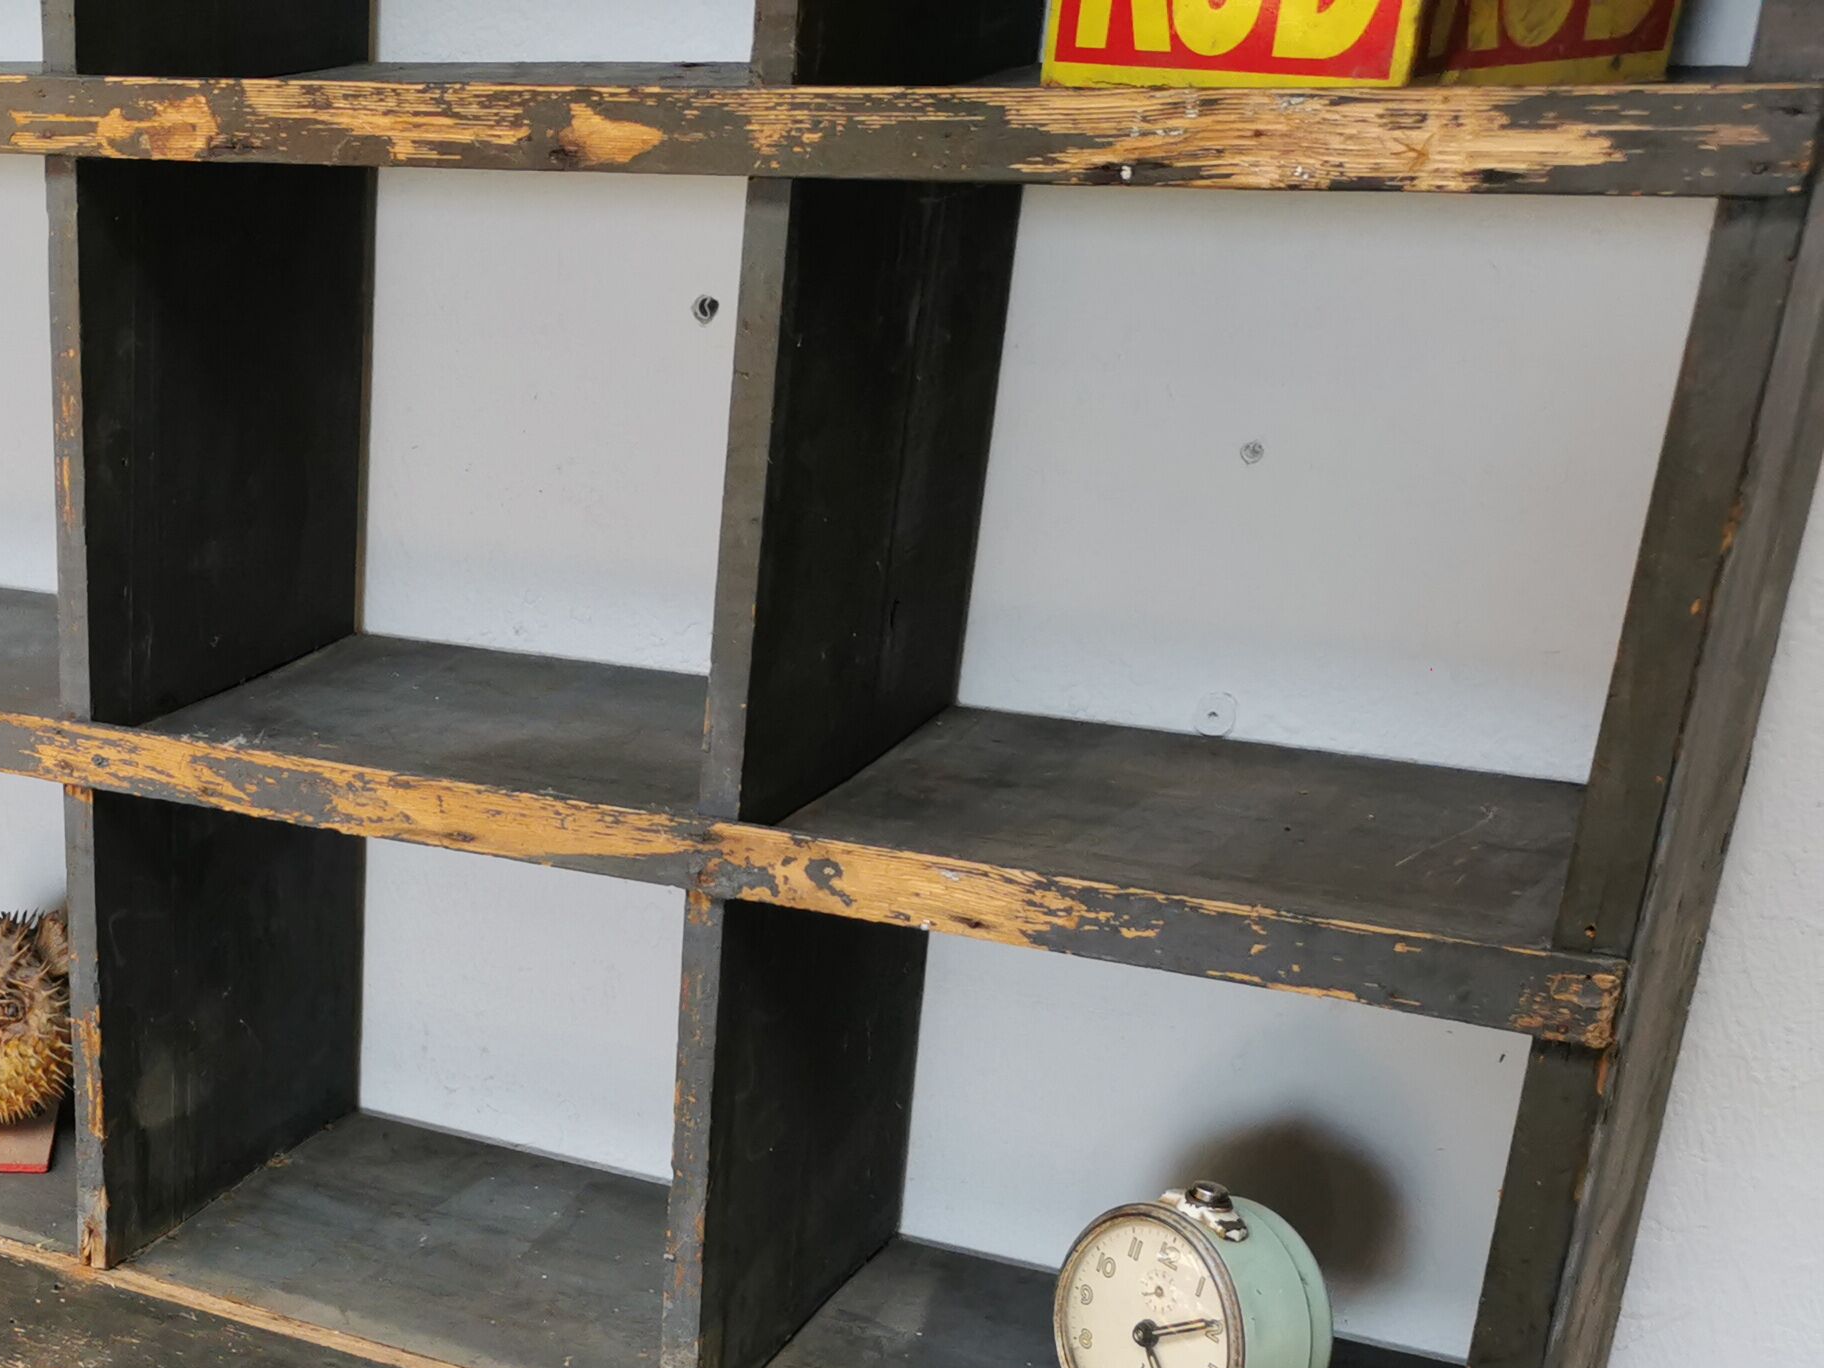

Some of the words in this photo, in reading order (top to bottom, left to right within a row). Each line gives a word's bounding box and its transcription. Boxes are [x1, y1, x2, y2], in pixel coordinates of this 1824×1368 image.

[1127, 1237, 1144, 1261] 11
[1159, 1241, 1180, 1271] 12
[1096, 1252, 1116, 1278] 10
[1080, 1284, 1094, 1305] 9
[1195, 1277, 1206, 1298] 1
[1079, 1328, 1093, 1349] 8
[1205, 1319, 1223, 1342] 2
